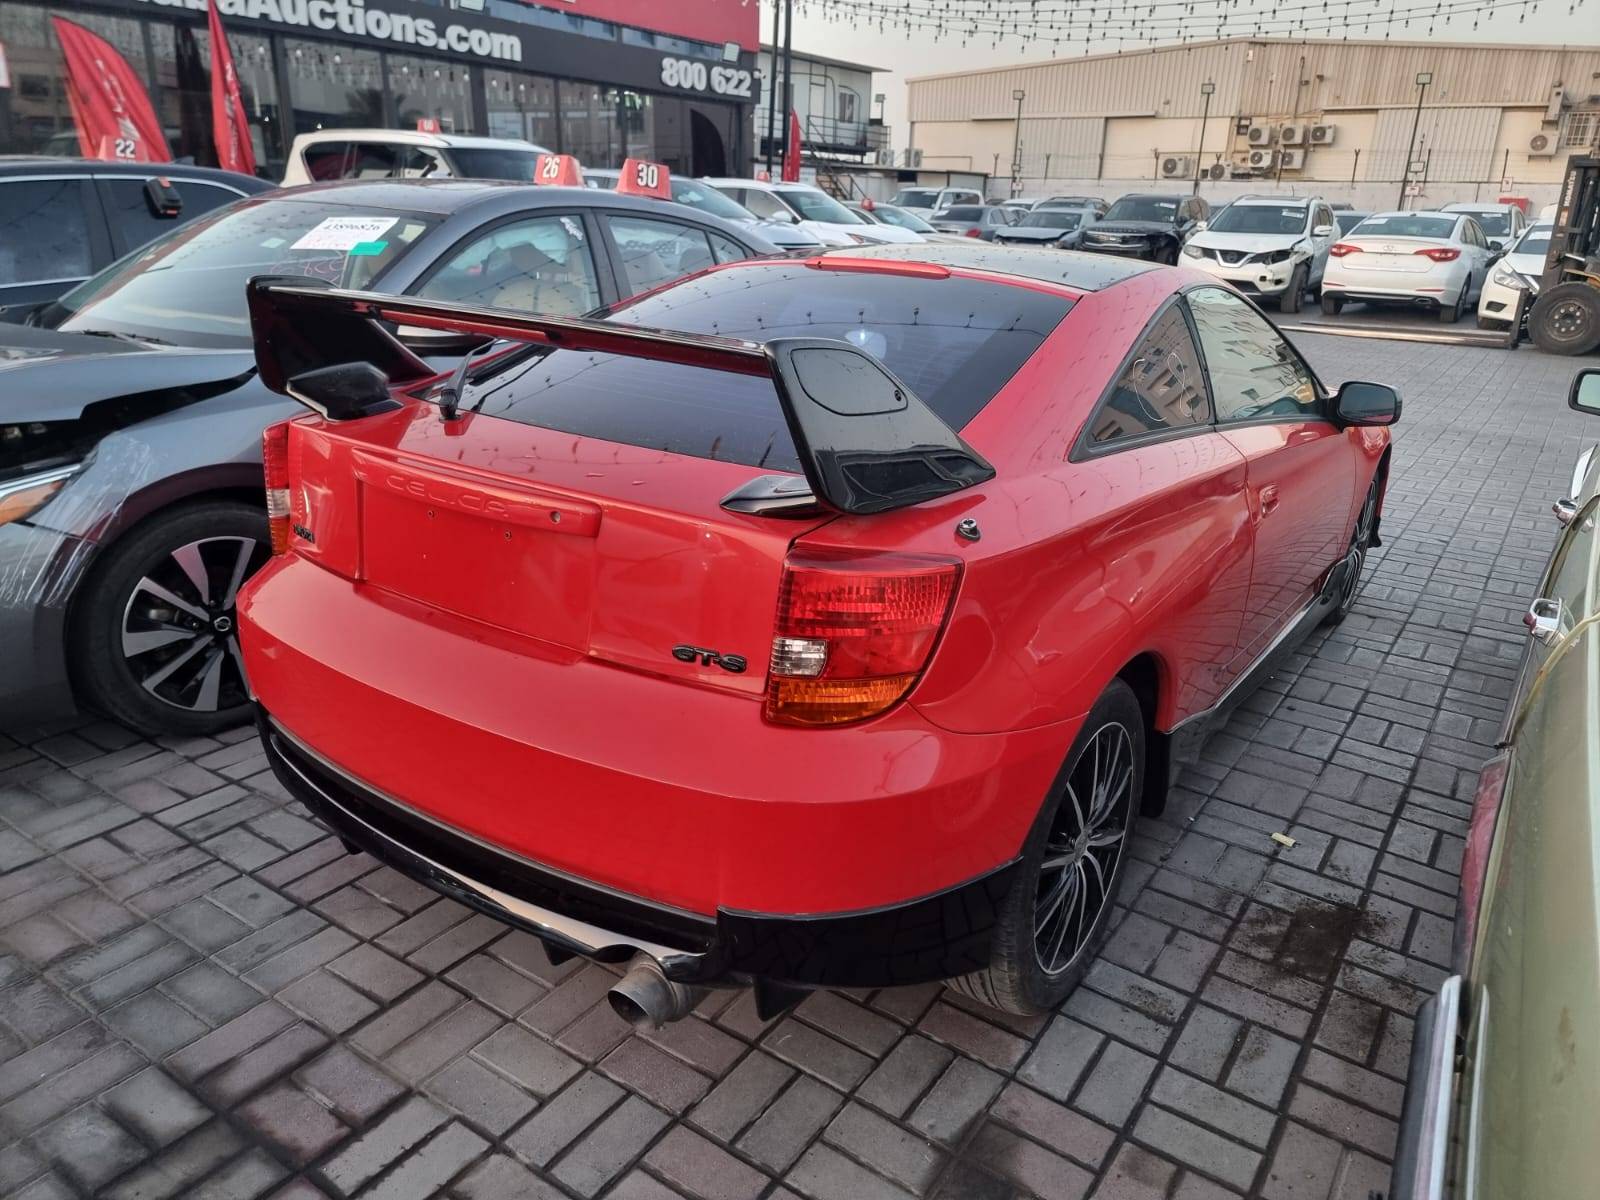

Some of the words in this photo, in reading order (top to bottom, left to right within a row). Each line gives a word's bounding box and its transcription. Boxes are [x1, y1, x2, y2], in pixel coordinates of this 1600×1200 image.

[661, 57, 707, 92] 800
[710, 66, 752, 98] 622
[115, 139, 136, 159] 22
[542, 157, 561, 178] 26
[637, 163, 659, 189] 30
[385, 474, 510, 518] CELCA
